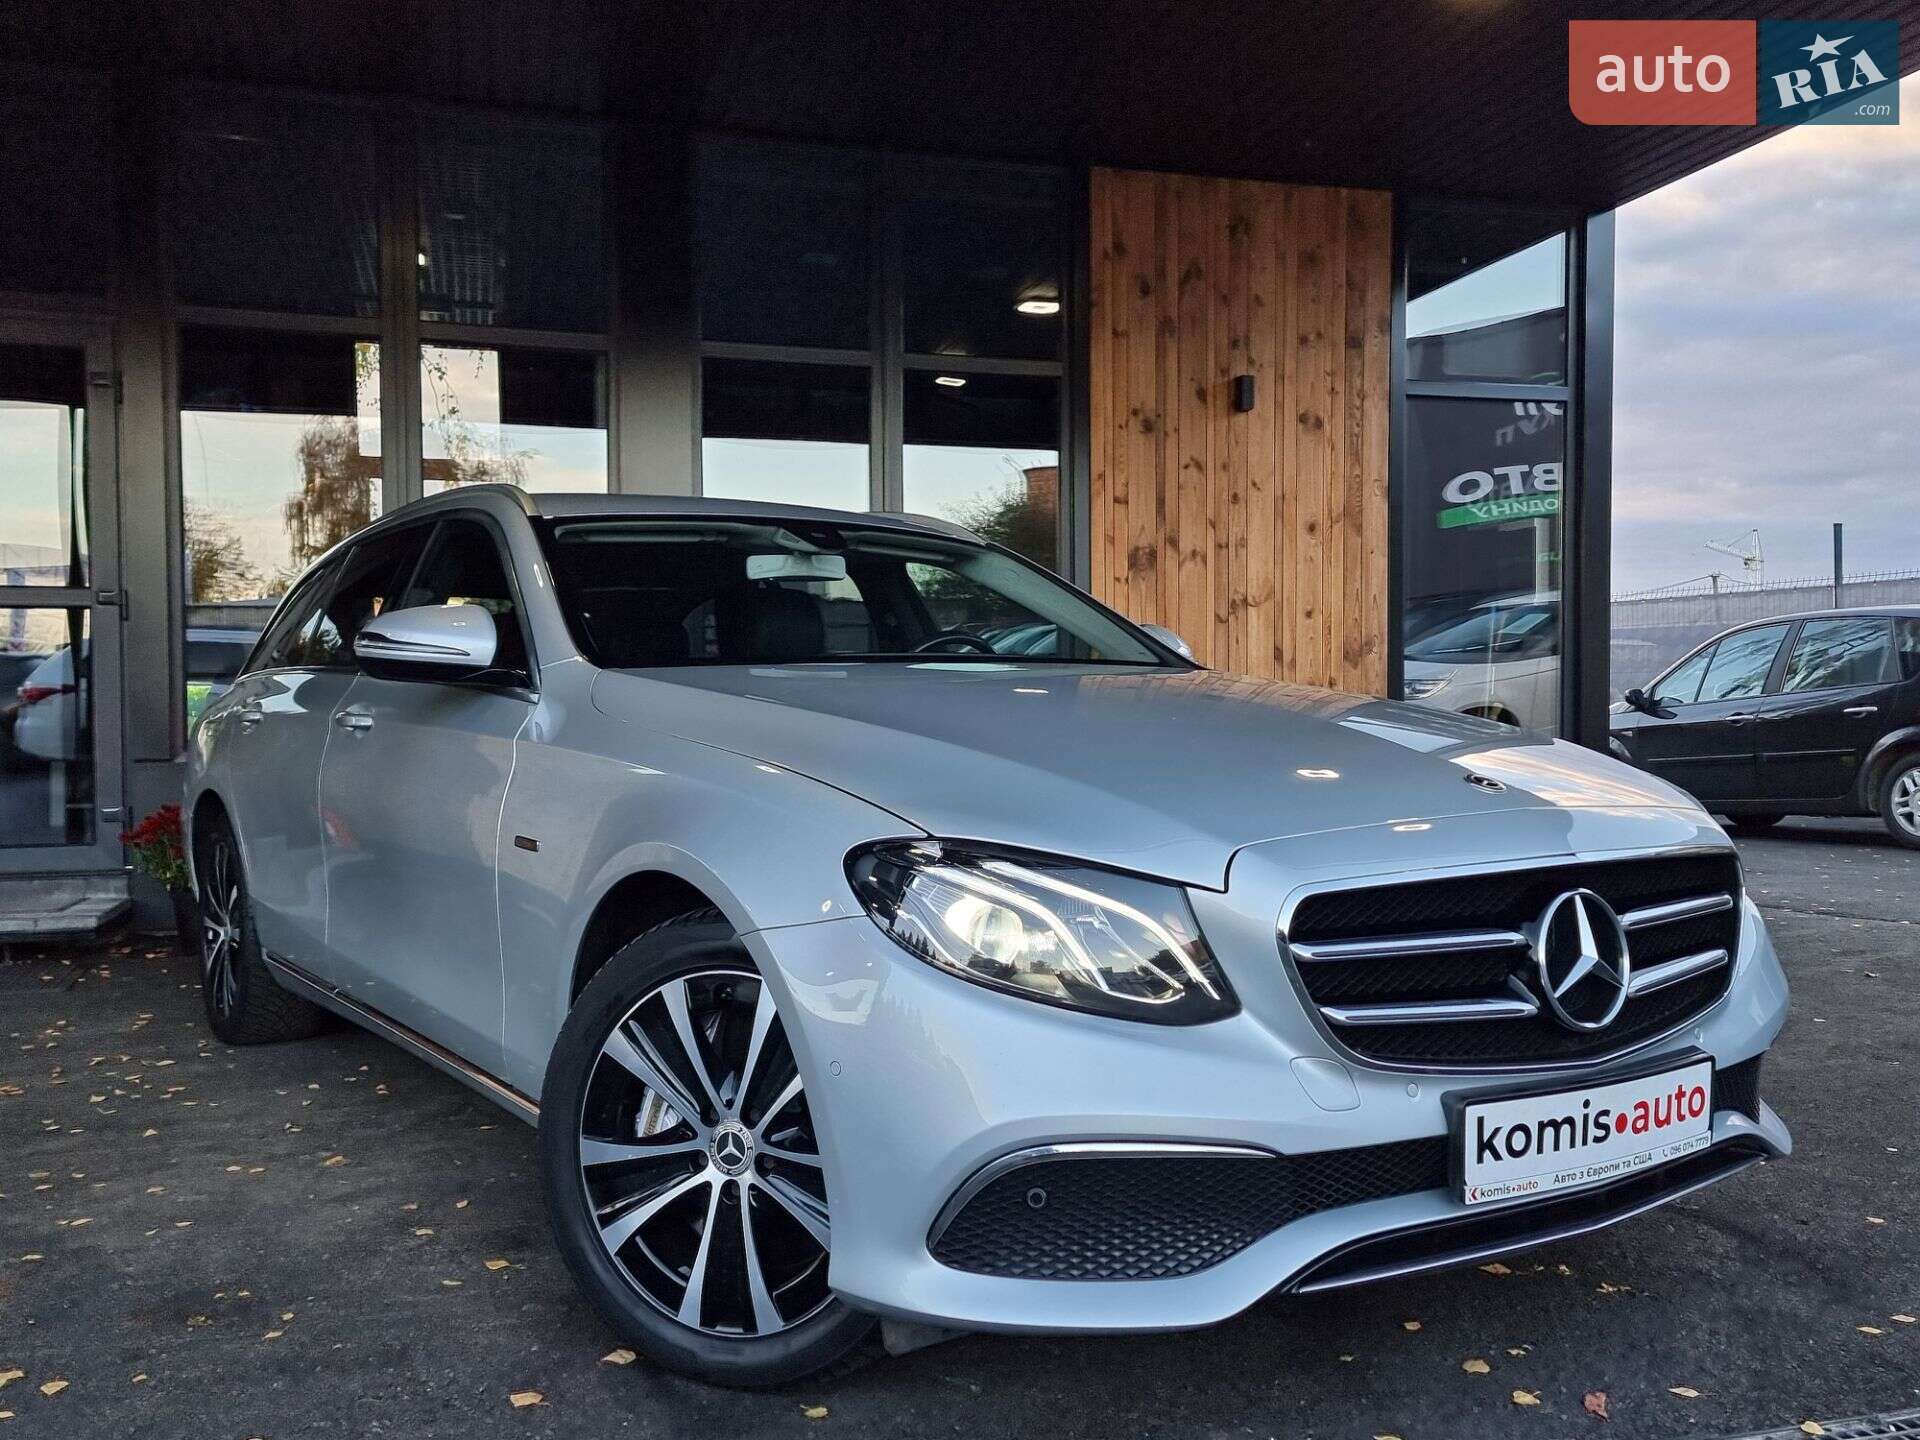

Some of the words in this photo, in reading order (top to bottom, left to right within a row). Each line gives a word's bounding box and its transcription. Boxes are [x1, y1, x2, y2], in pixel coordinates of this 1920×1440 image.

[1553, 1173, 1577, 1185] Авто
[1586, 1161, 1620, 1178] Європи
[1622, 1160, 1632, 1170] та
[1633, 1152, 1653, 1166] США
